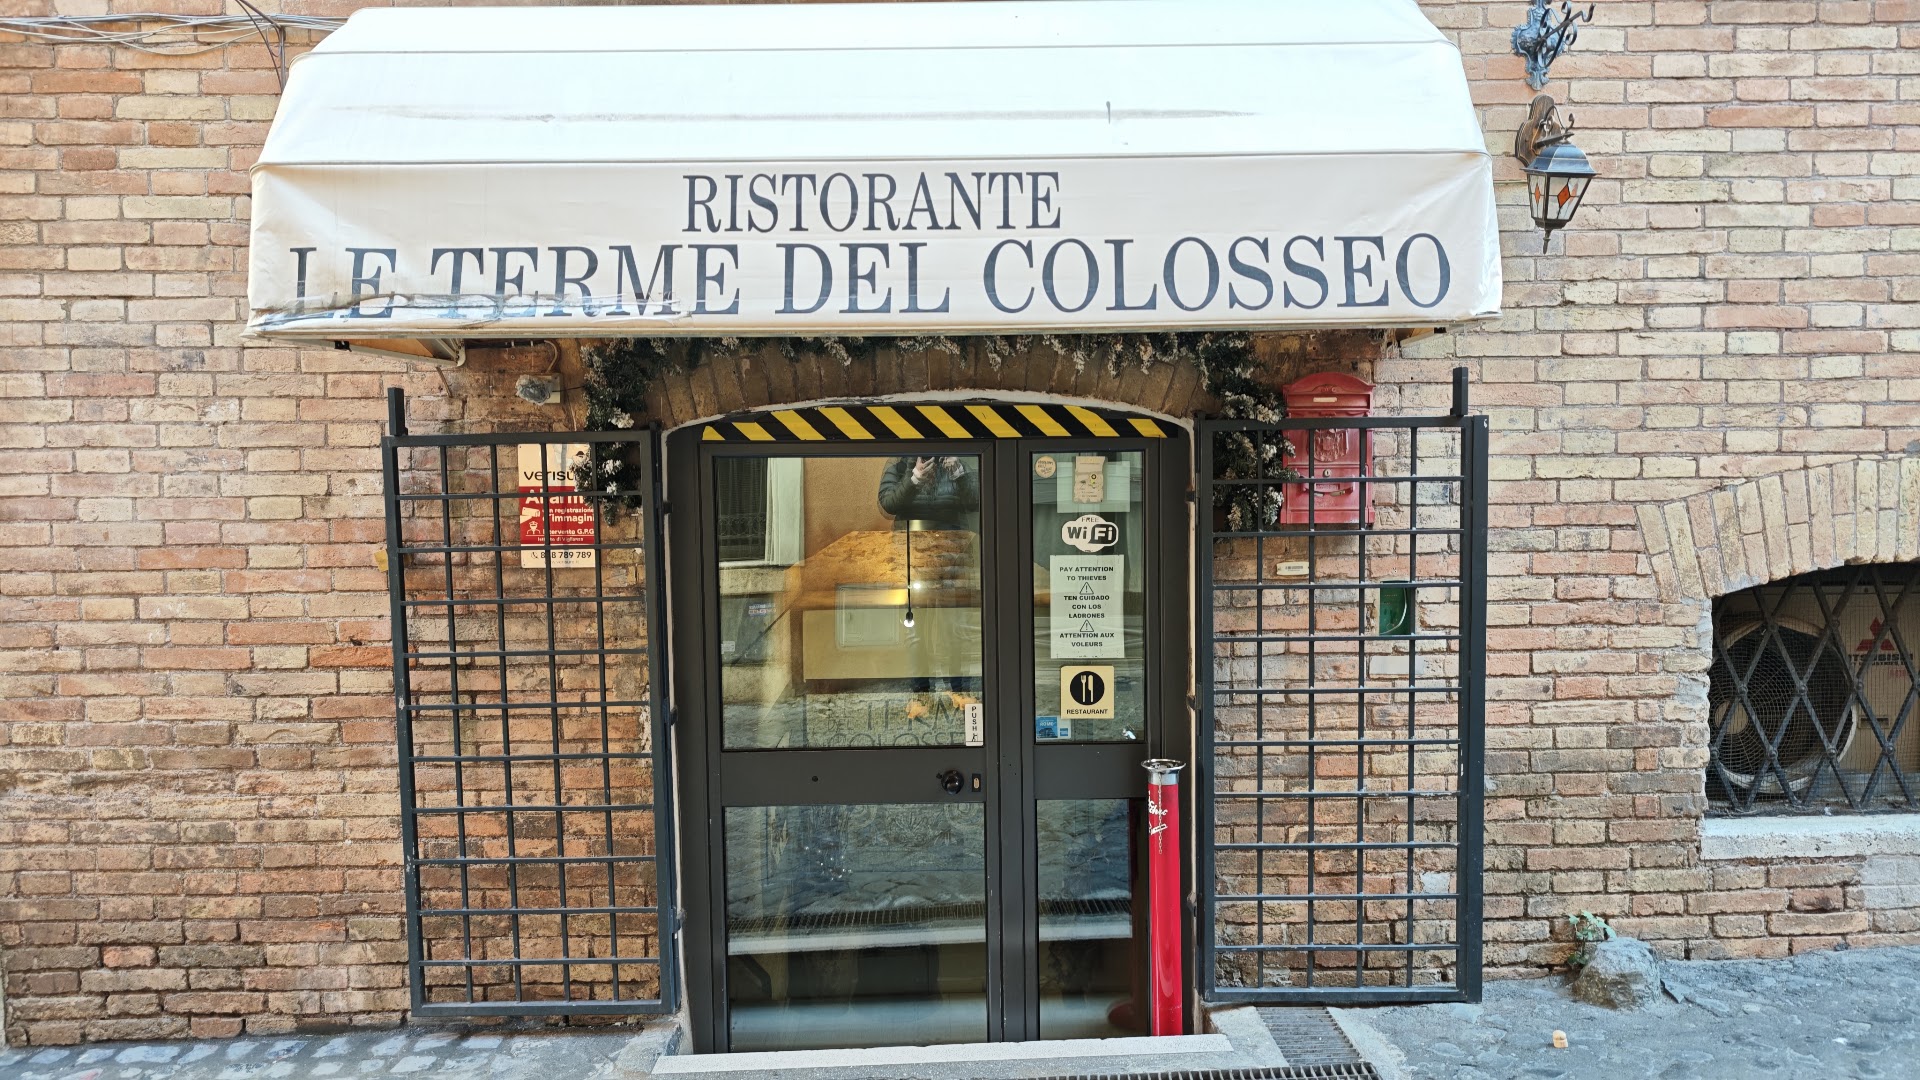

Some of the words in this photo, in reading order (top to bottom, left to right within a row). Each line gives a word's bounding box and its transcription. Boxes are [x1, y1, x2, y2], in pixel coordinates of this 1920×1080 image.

[682, 171, 1062, 233] RISTORANTE
[289, 246, 397, 319] LE
[430, 244, 740, 318] TERME
[775, 242, 950, 314] DEL
[983, 232, 1451, 314] COLOSSEO
